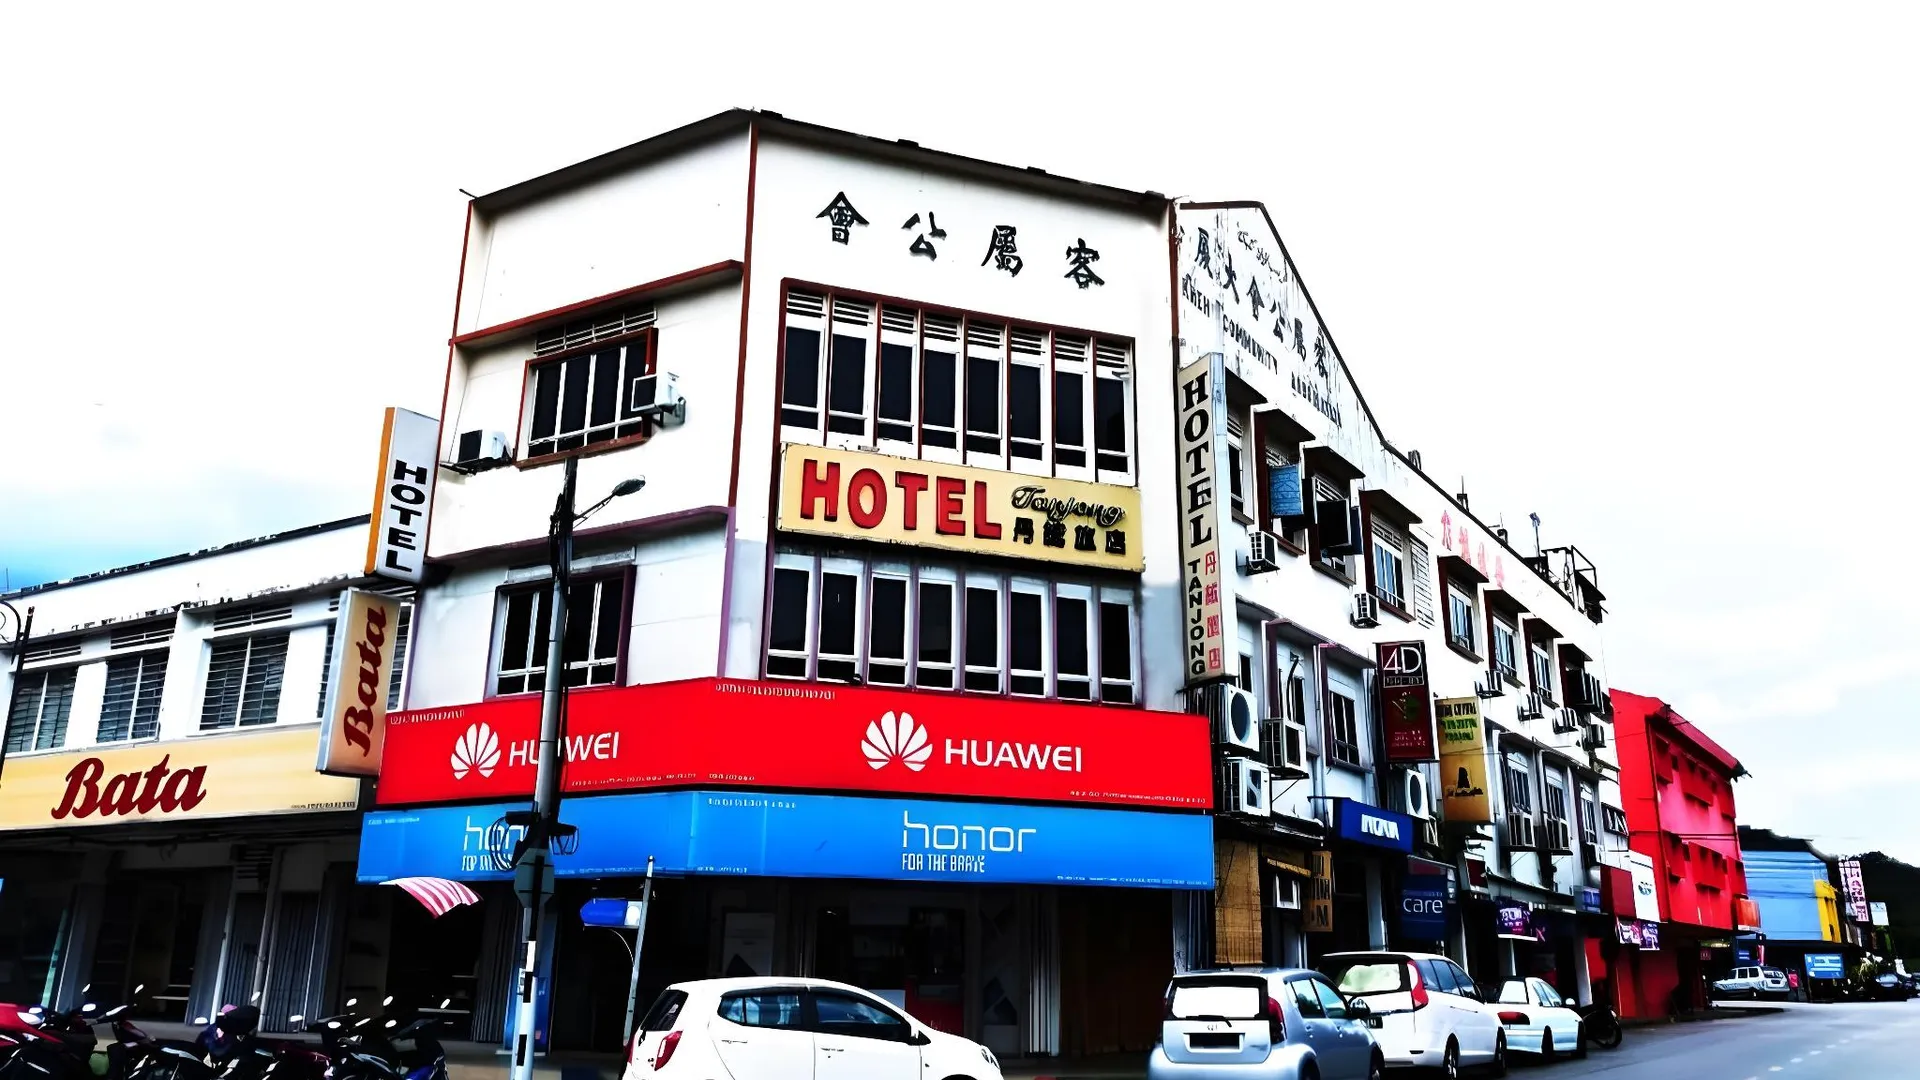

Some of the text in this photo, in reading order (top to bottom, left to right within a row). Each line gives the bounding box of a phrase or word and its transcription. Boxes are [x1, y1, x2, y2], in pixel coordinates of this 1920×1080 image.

[1182, 371, 1212, 549] HOTEL
[385, 459, 428, 574] HOTEL
[800, 458, 1002, 541] HOTEL
[1187, 557, 1206, 675] TANJONG
[345, 605, 388, 757] Bata
[1383, 645, 1422, 675] 4D
[508, 731, 620, 767] HUWEI
[944, 738, 1082, 773] HUAWEI
[51, 753, 207, 820] Bata
[463, 815, 530, 852] hon
[902, 810, 1037, 853] honor
[902, 853, 923, 871] FOR
[927, 854, 947, 872] THE
[1402, 897, 1444, 914] care
